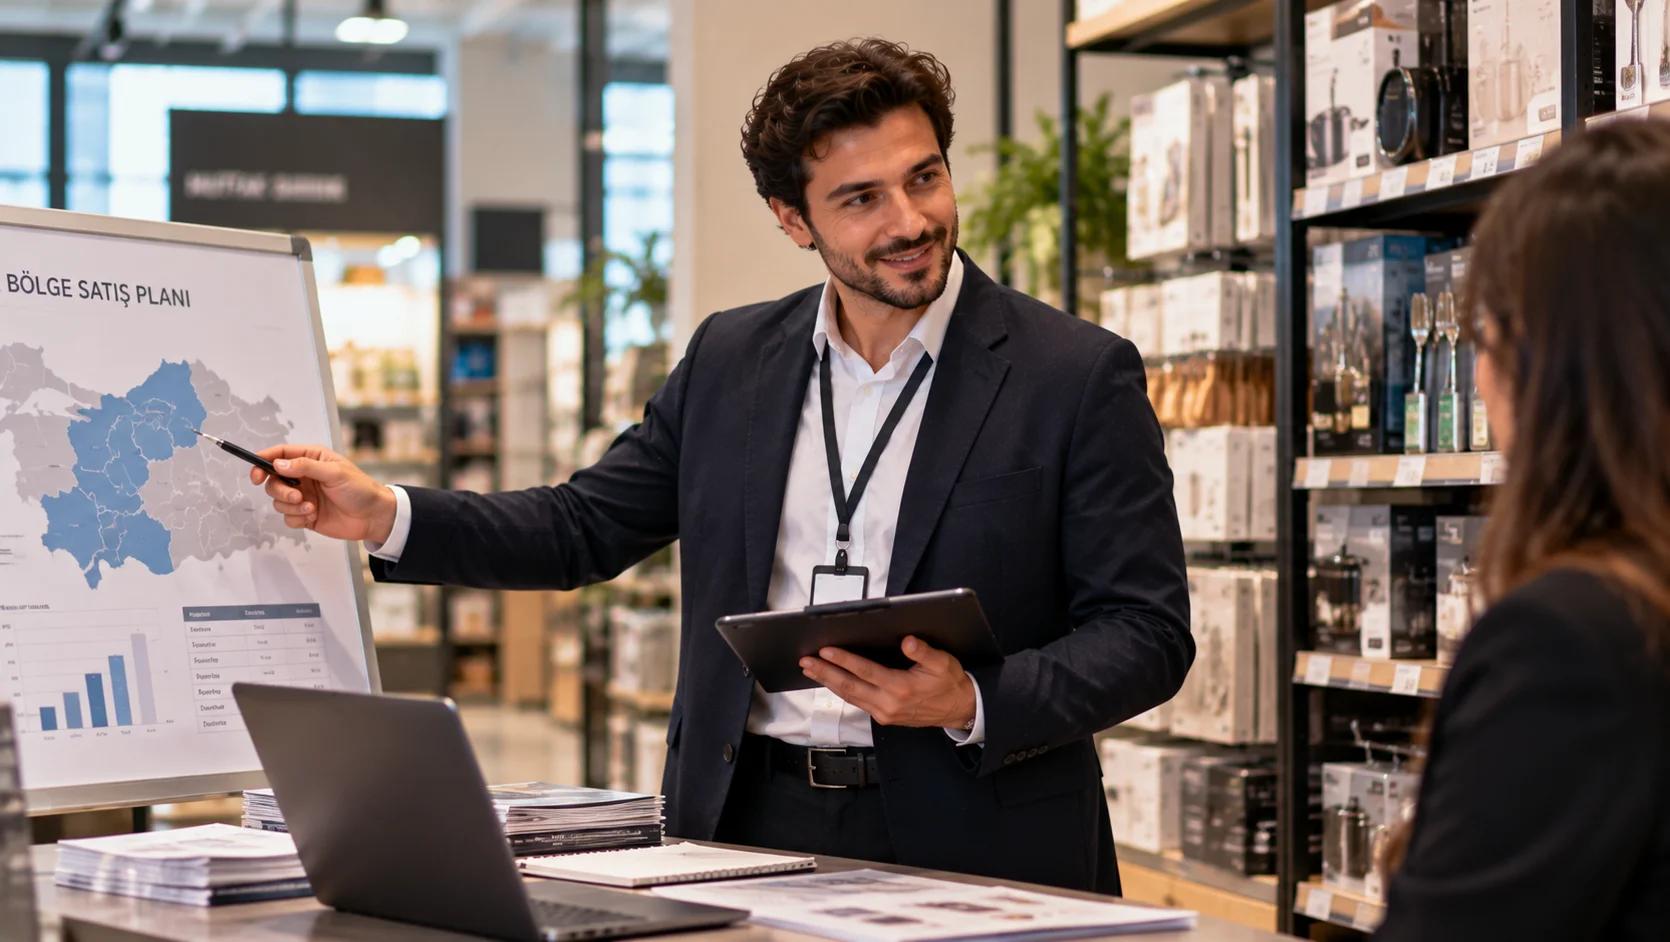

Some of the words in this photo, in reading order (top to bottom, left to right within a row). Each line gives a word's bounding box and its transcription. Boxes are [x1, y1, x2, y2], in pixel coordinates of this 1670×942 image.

[6, 270, 73, 297] BÖLGE
[79, 280, 131, 308] SATIŞ
[136, 285, 191, 308] PLANI
